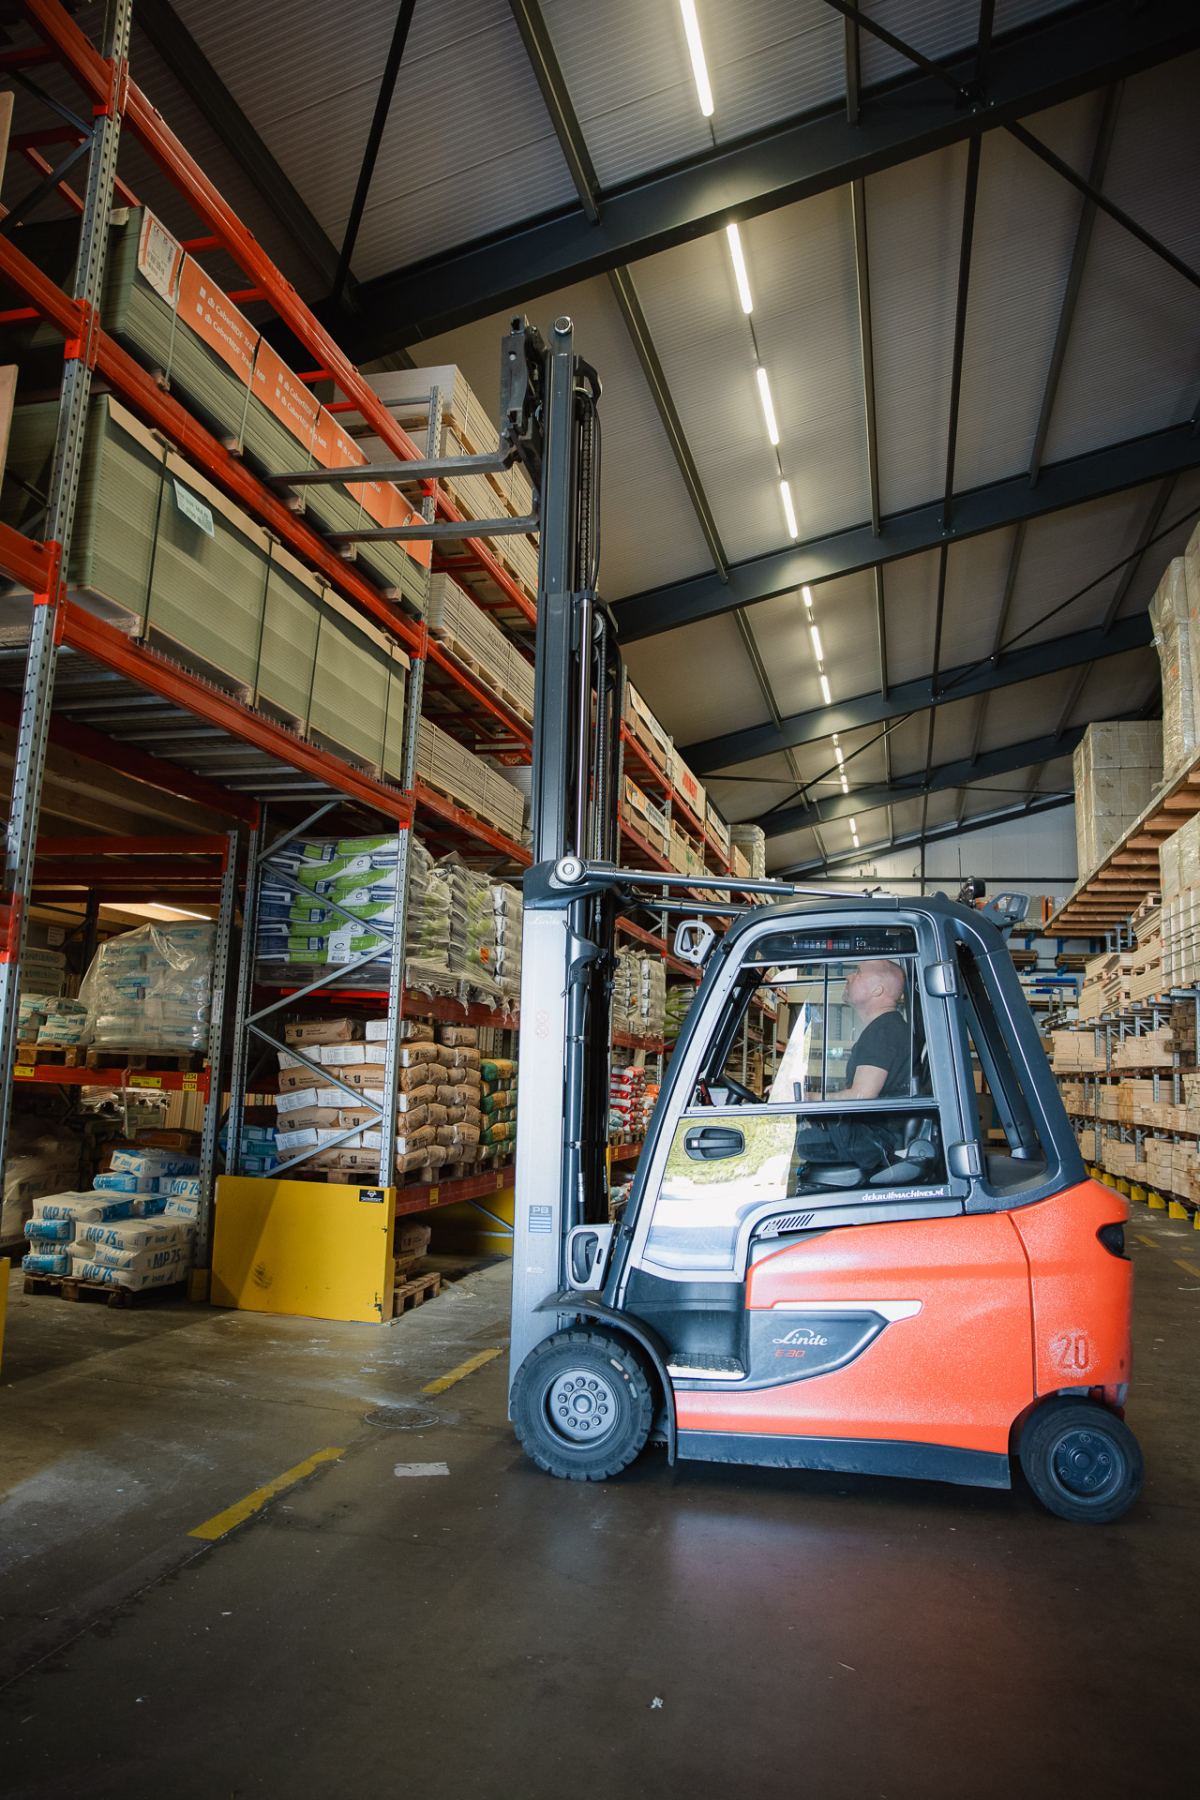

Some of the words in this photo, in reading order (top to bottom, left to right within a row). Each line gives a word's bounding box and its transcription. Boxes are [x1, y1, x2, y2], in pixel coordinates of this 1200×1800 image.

[170, 1180, 188, 1196] MP
[42, 1206, 59, 1220] MP
[61, 1207, 73, 1220] 75
[532, 1206, 549, 1214] PB
[86, 1227, 104, 1243] MP
[105, 1230, 119, 1246] 75
[39, 1242, 55, 1255] MP
[153, 1251, 170, 1269] MP
[170, 1248, 181, 1264] 75
[82, 1264, 100, 1280] MP
[101, 1267, 115, 1284] 75
[772, 1328, 828, 1346] Linde
[775, 1349, 786, 1357] E
[785, 1349, 806, 1358] 30
